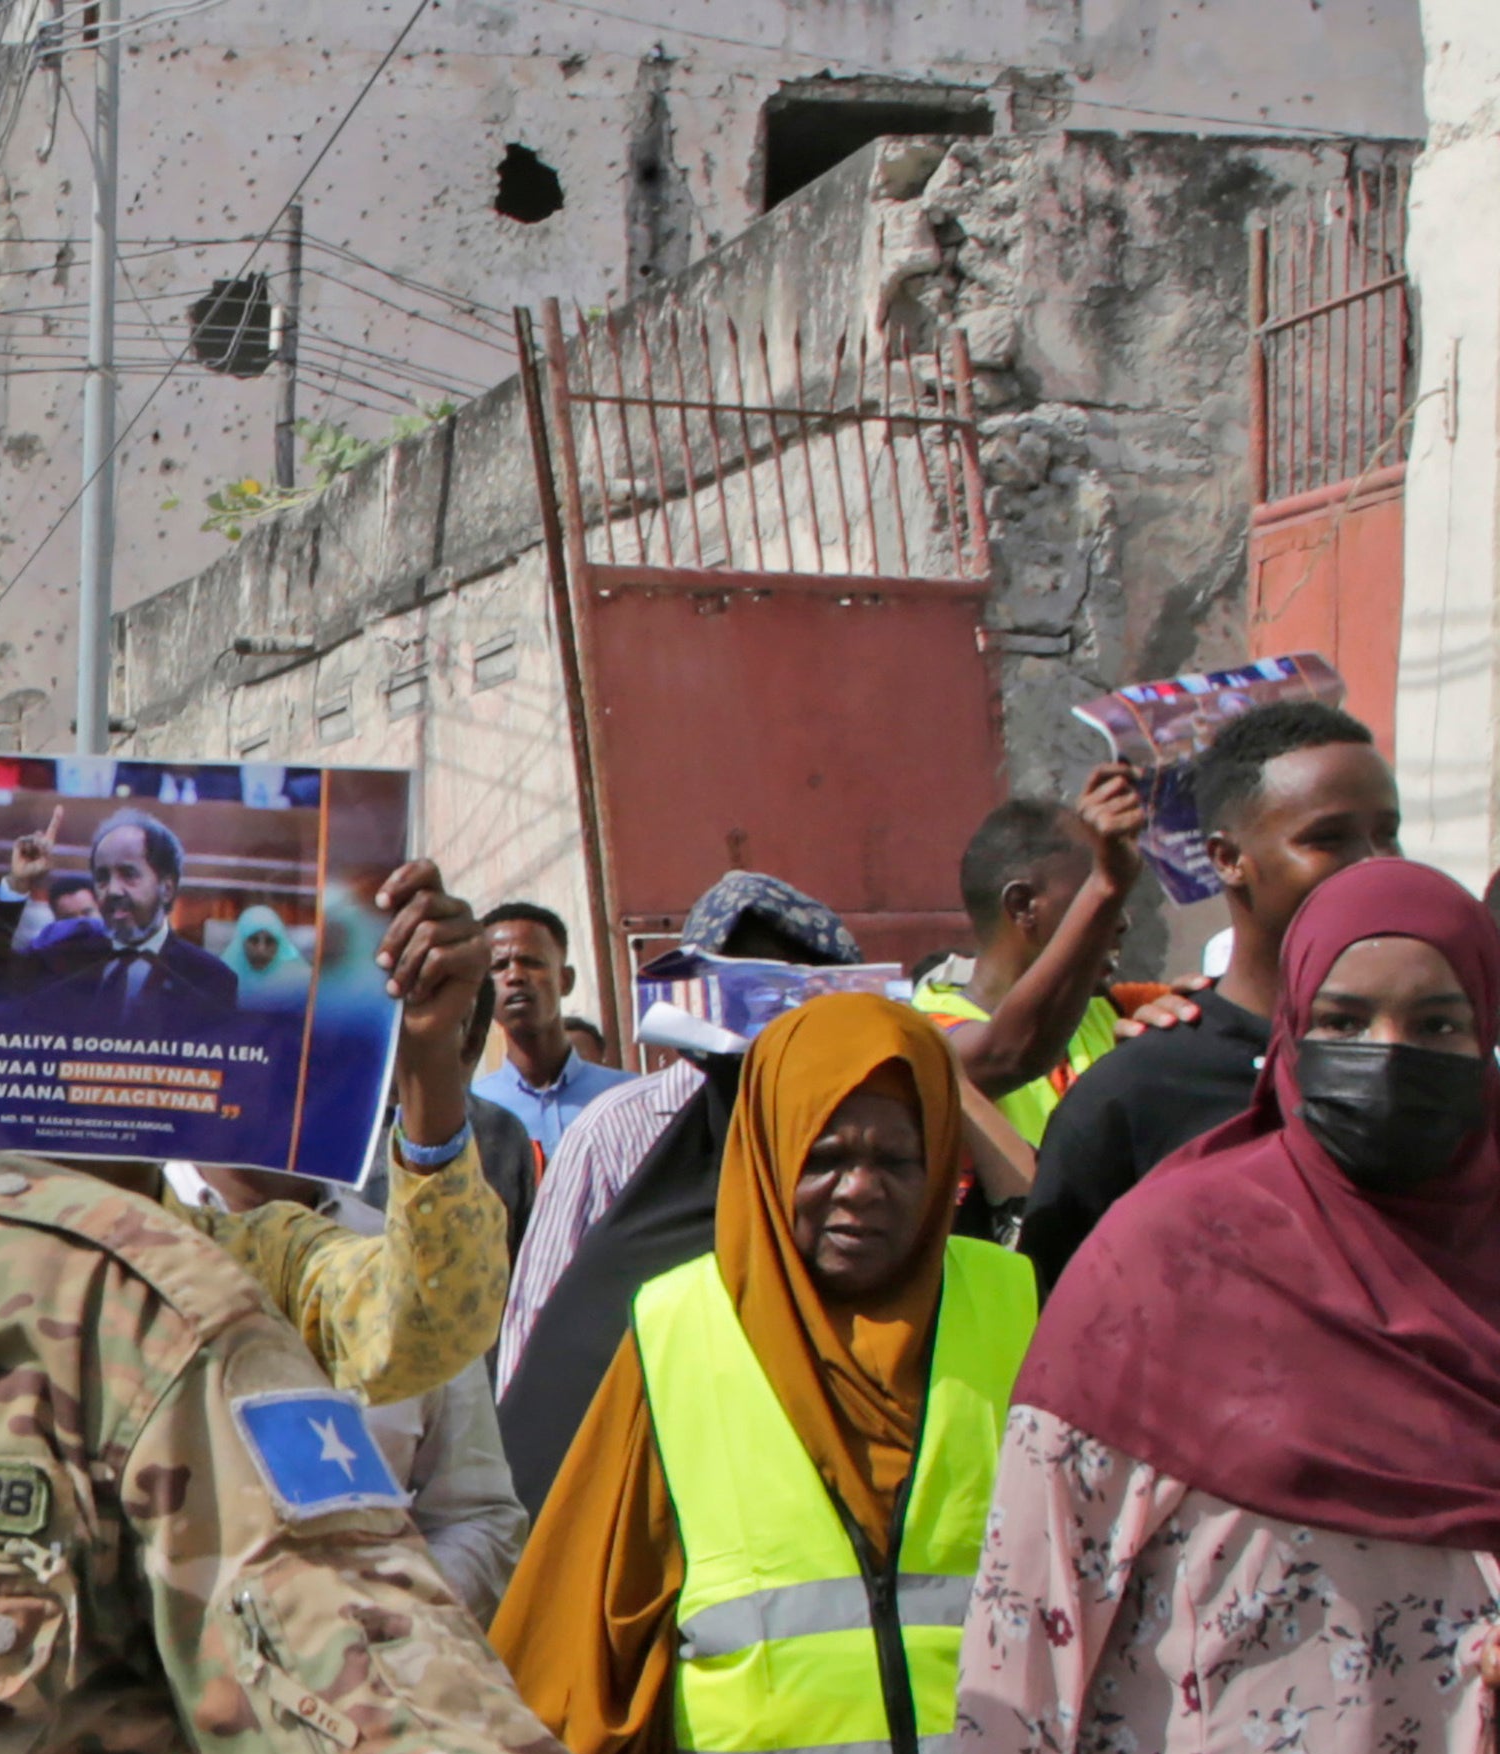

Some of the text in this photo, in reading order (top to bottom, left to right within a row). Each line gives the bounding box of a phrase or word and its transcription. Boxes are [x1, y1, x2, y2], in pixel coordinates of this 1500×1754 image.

[71, 1037, 177, 1056] SOOMAALI
[181, 1042, 224, 1061] BAA
[228, 1045, 270, 1065] LEH,
[42, 1062, 57, 1077] U
[59, 1064, 221, 1089] DHIMANEYNAA,
[69, 1086, 217, 1112] DIFAACEYNAA
